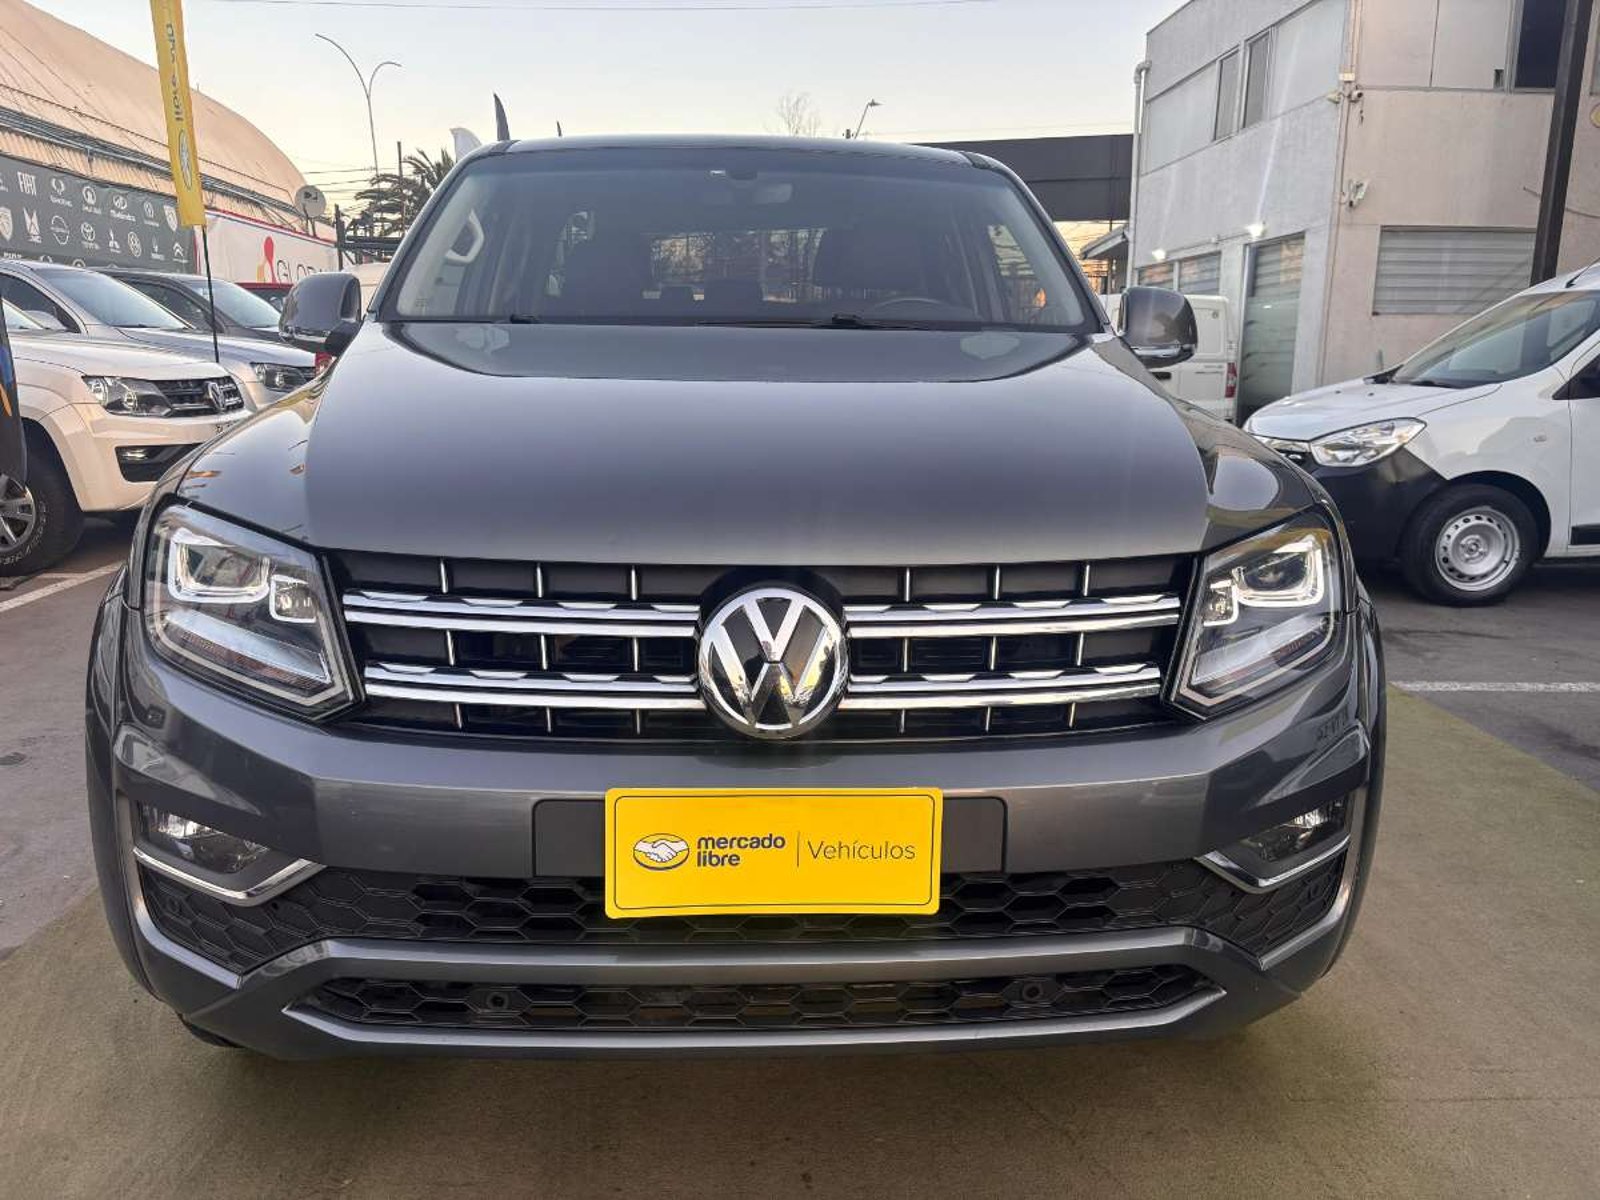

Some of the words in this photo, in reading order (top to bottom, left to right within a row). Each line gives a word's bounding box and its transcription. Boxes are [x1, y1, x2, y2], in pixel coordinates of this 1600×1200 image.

[17, 171, 37, 196] FIAT
[696, 832, 786, 850] mercado
[807, 840, 916, 860] Vehículos
[696, 850, 741, 868] libre
